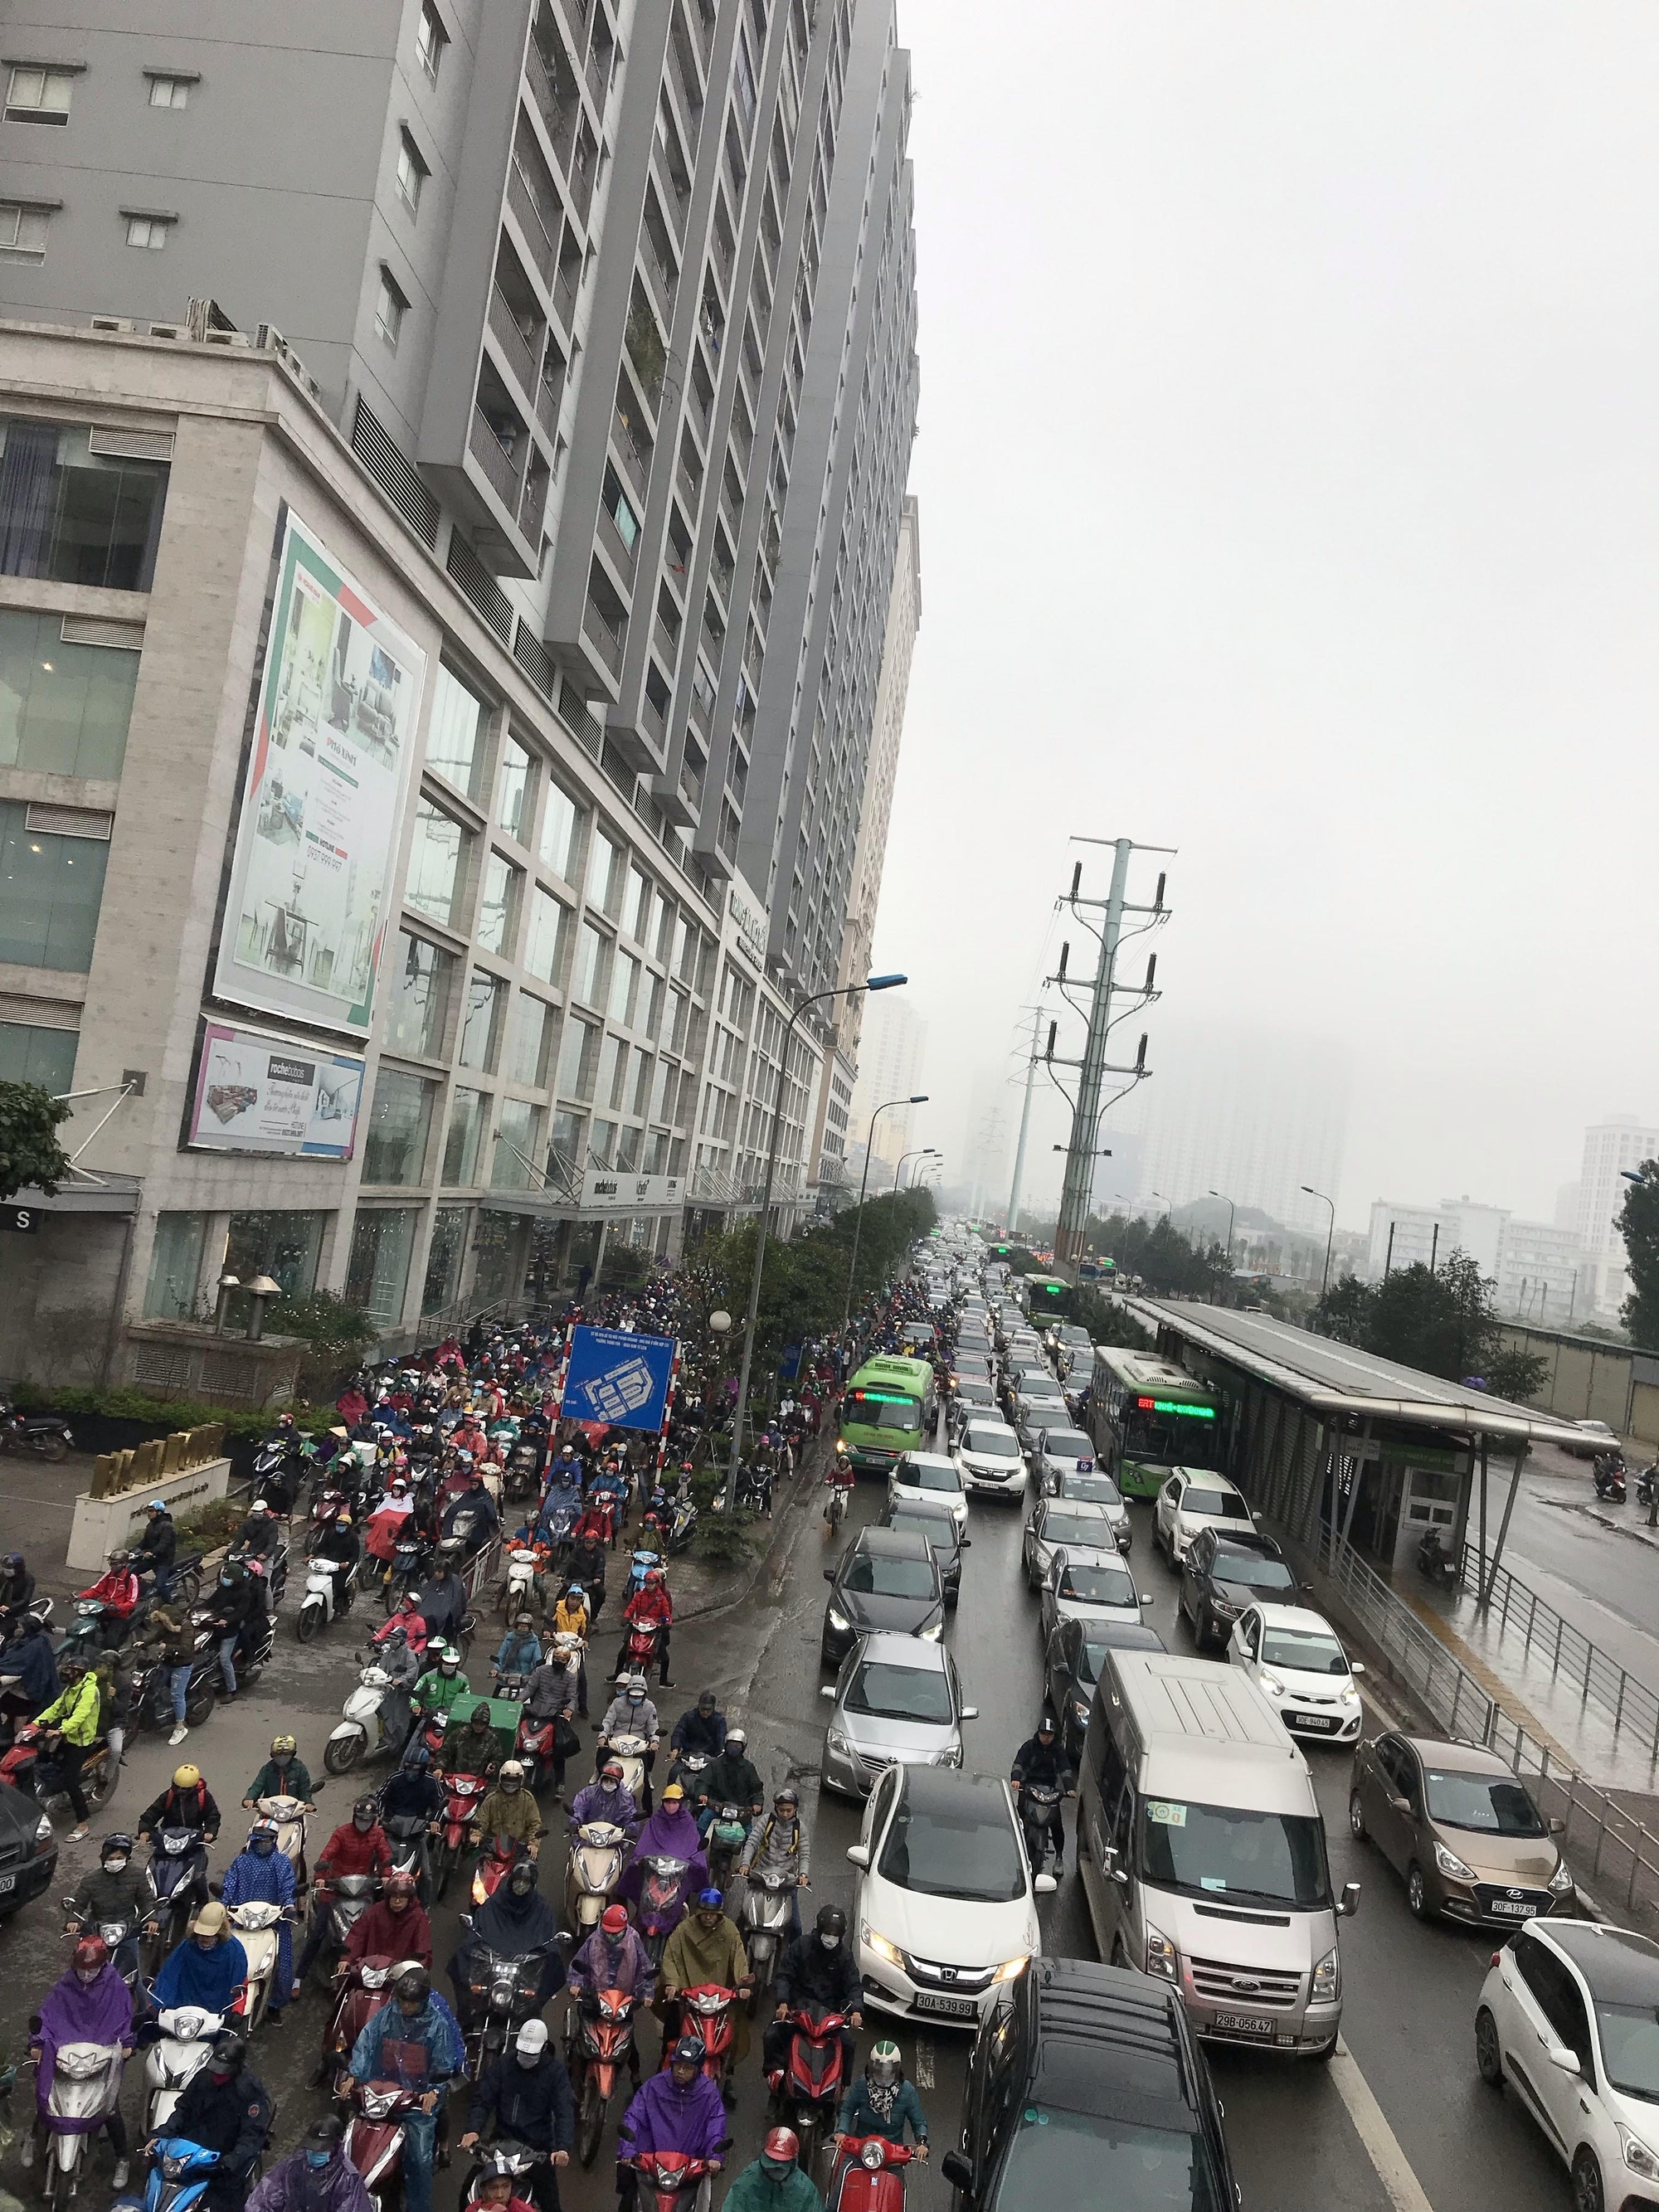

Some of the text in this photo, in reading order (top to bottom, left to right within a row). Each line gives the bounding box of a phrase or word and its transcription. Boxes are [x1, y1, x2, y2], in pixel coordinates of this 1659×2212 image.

[16, 1210, 30, 1228] S
[918, 1996, 971, 2015] 30A-539.99
[1218, 2015, 1271, 2032] 29B-056.47
